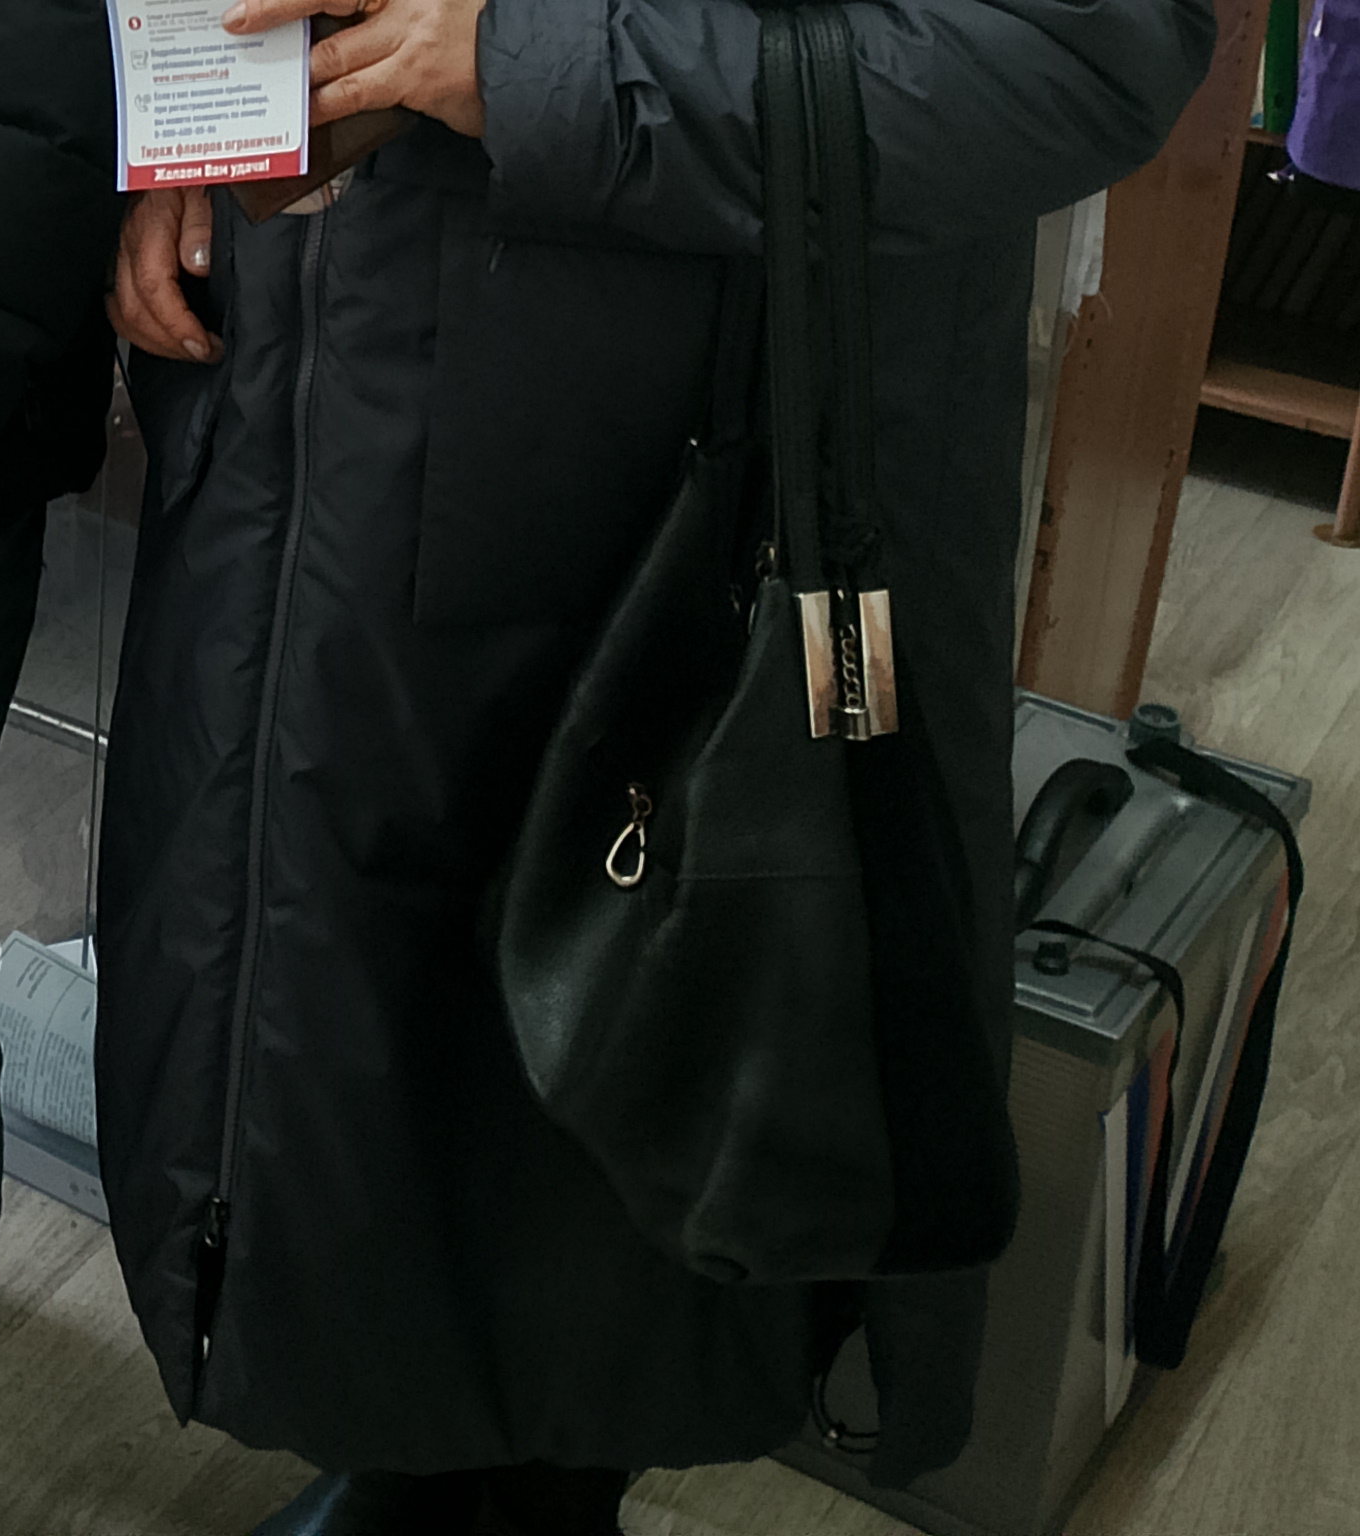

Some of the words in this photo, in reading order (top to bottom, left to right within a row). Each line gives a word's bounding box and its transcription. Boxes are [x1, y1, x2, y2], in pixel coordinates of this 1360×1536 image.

[154, 167, 202, 181] Желаем
[205, 164, 228, 177] Вам
[230, 158, 270, 177] удачи!
